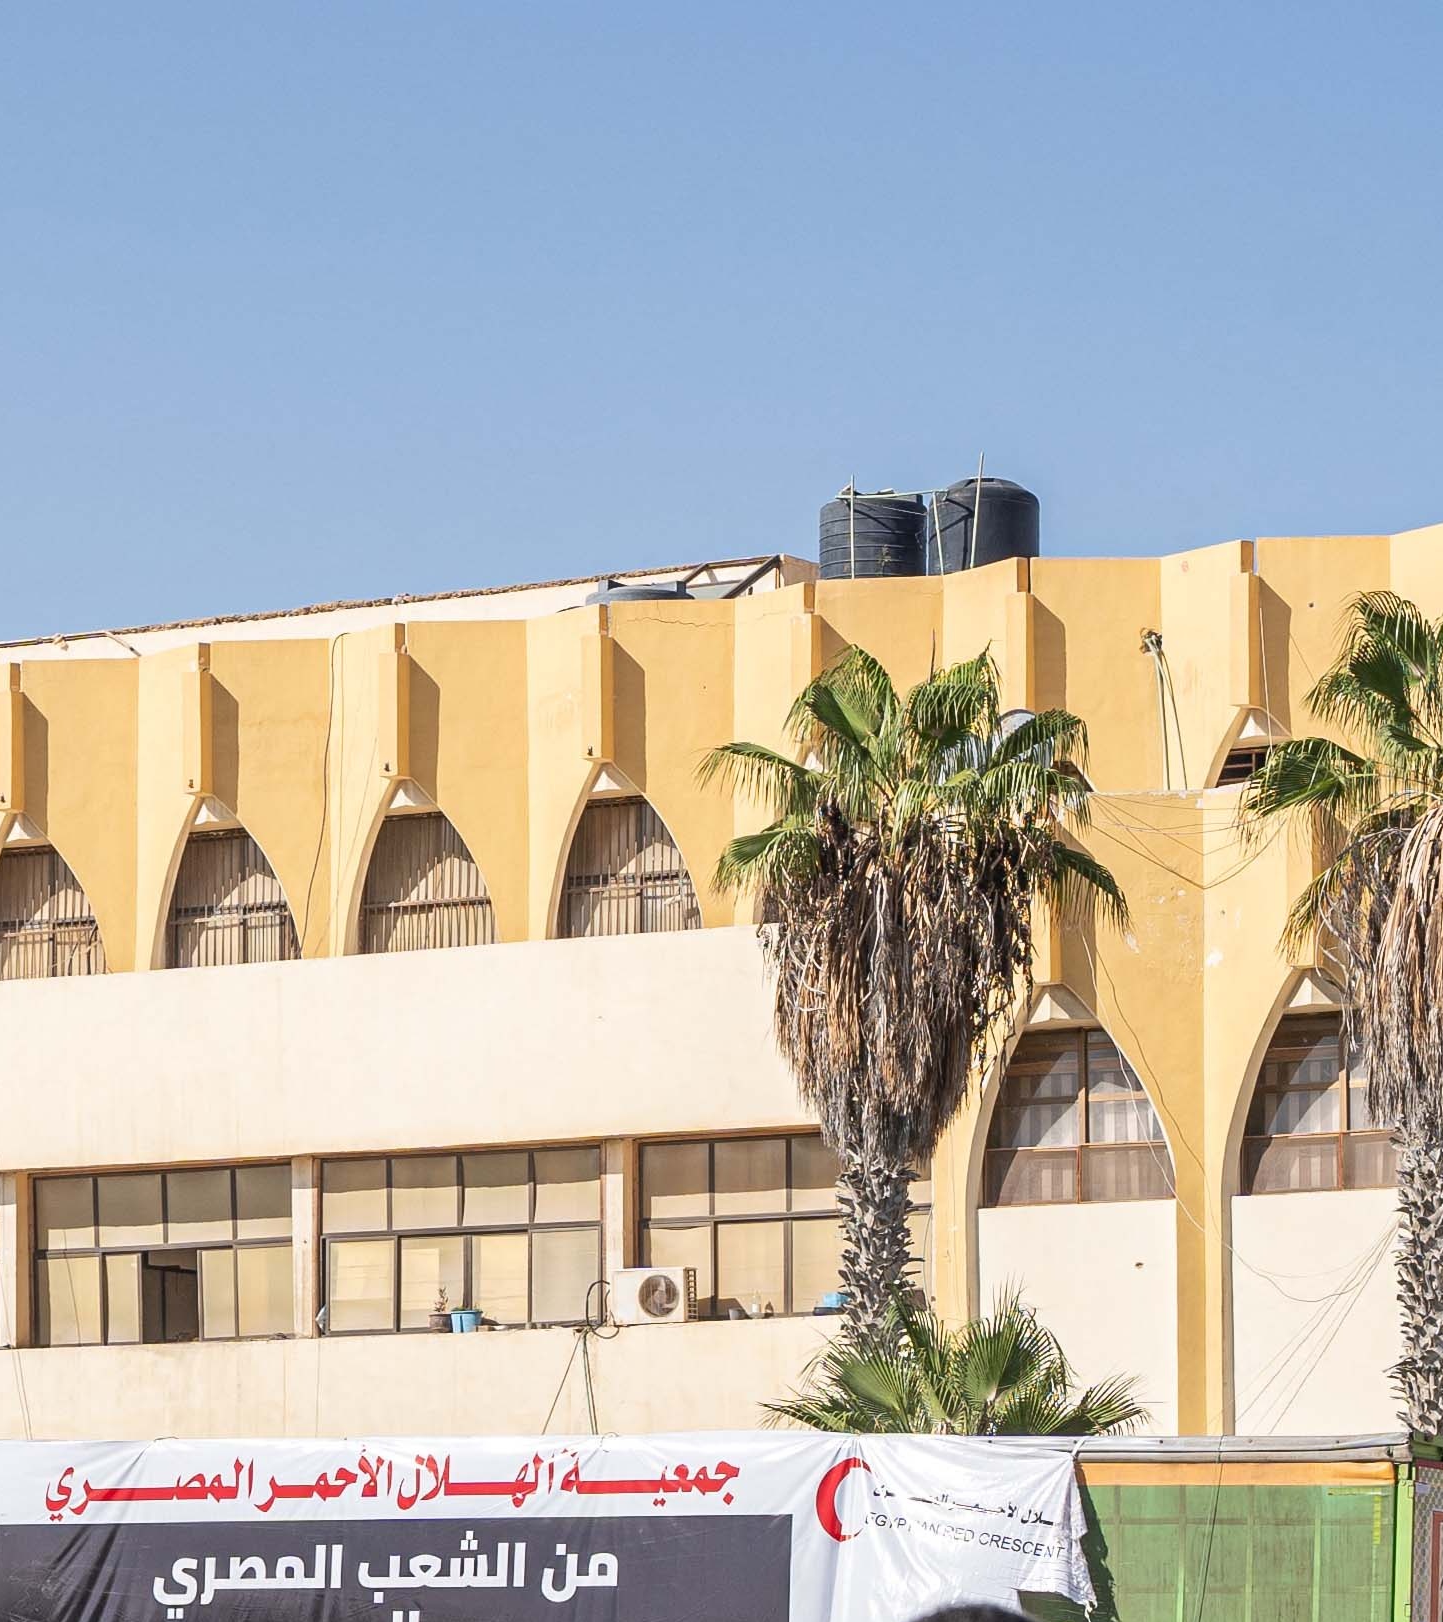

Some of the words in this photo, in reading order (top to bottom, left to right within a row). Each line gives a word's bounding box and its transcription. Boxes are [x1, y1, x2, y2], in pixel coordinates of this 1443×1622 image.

[45, 1456, 253, 1522] المصري
[398, 1451, 555, 1510] الهلال
[560, 1448, 740, 1506] جمعية
[865, 1511, 939, 1536] EGYPAN
[978, 1531, 1066, 1560] CRESCENT
[152, 1544, 344, 1620] المصري
[357, 1530, 526, 1603] الشعب
[541, 1543, 618, 1603] من
